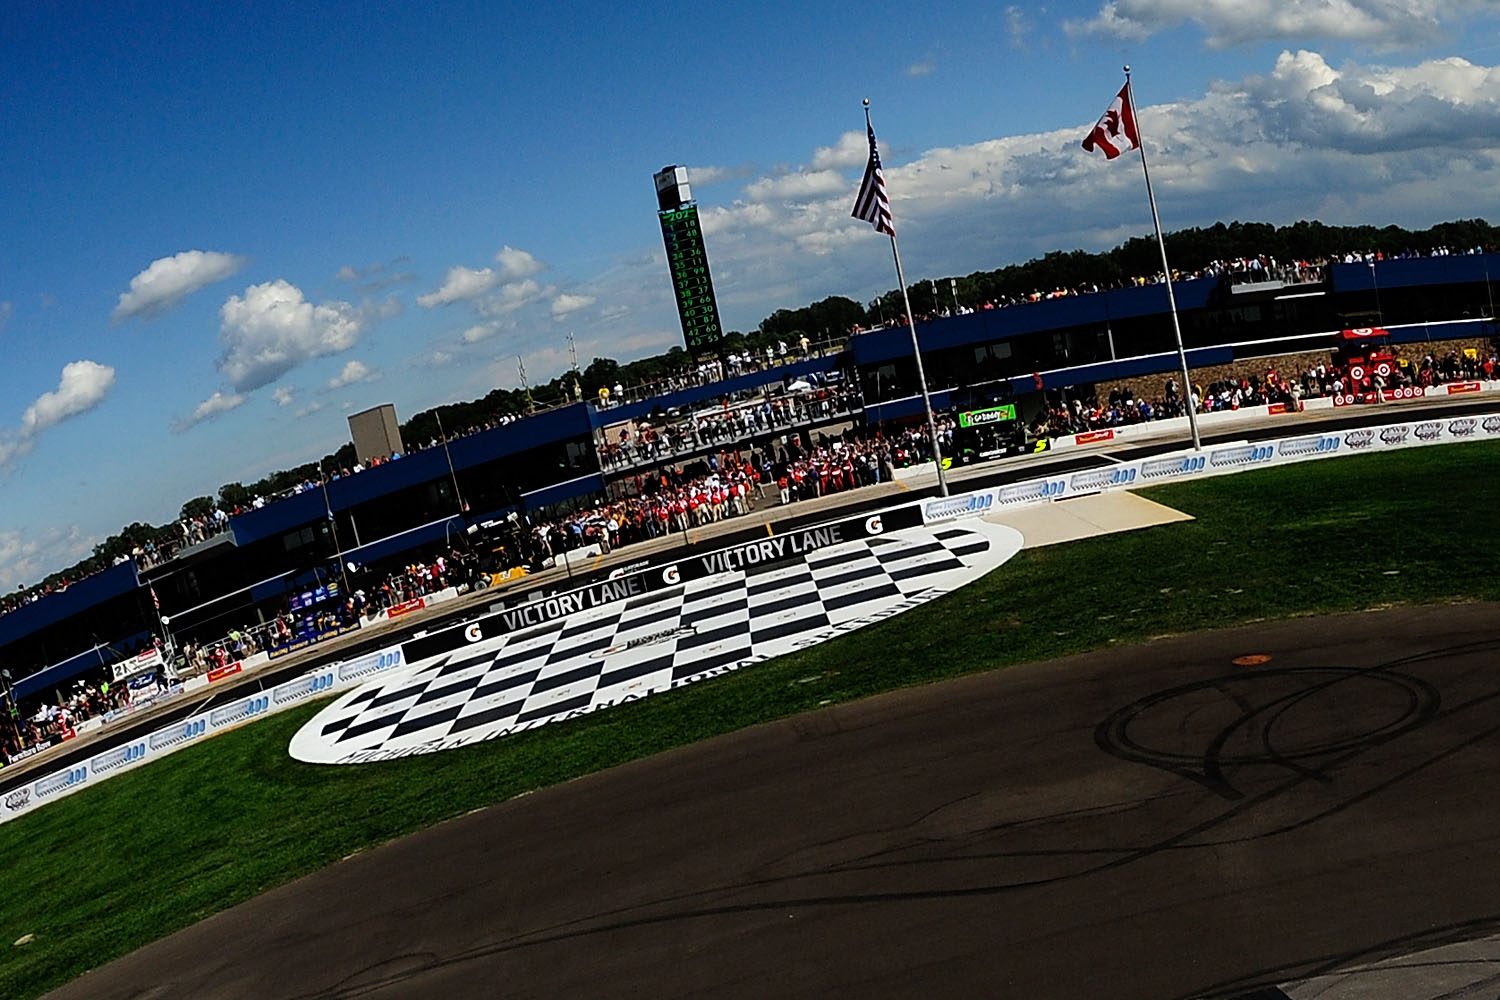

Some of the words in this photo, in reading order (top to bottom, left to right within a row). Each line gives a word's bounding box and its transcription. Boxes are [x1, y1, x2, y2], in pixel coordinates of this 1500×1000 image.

[669, 210, 689, 221] 202
[685, 220, 695, 228] 18
[687, 229, 697, 237] 48
[690, 248, 701, 256] 36
[674, 261, 686, 270] 35
[692, 257, 702, 265] 11
[676, 271, 688, 279] 36
[693, 266, 705, 274] 99
[678, 280, 689, 288] 37
[696, 276, 707, 284] 13
[680, 289, 691, 298] 38
[698, 285, 708, 294] 37
[682, 299, 693, 308] 39
[700, 295, 711, 304] 66
[684, 309, 696, 317] 40
[702, 305, 713, 313] 30
[686, 318, 697, 327] 41
[703, 314, 714, 323] 87
[688, 328, 699, 336] 42
[705, 323, 717, 332] 60
[707, 334, 719, 342] 55
[1034, 439, 1048, 453] 5
[1317, 437, 1340, 450] 400
[1249, 445, 1273, 461] 400
[941, 457, 953, 471] 5
[1182, 456, 1205, 472] 400
[1112, 468, 1136, 484] 400
[1041, 480, 1065, 497] 400
[968, 494, 993, 510] 400
[702, 537, 786, 575] VICTORY
[790, 525, 844, 554] LANE
[502, 592, 584, 631] VICTORY
[584, 576, 641, 607] LANE
[377, 651, 401, 669] 400
[310, 673, 334, 691] 400
[247, 695, 269, 714] 400
[185, 719, 206, 737] 400
[126, 743, 145, 761] 400
[67, 766, 87, 784] 400
